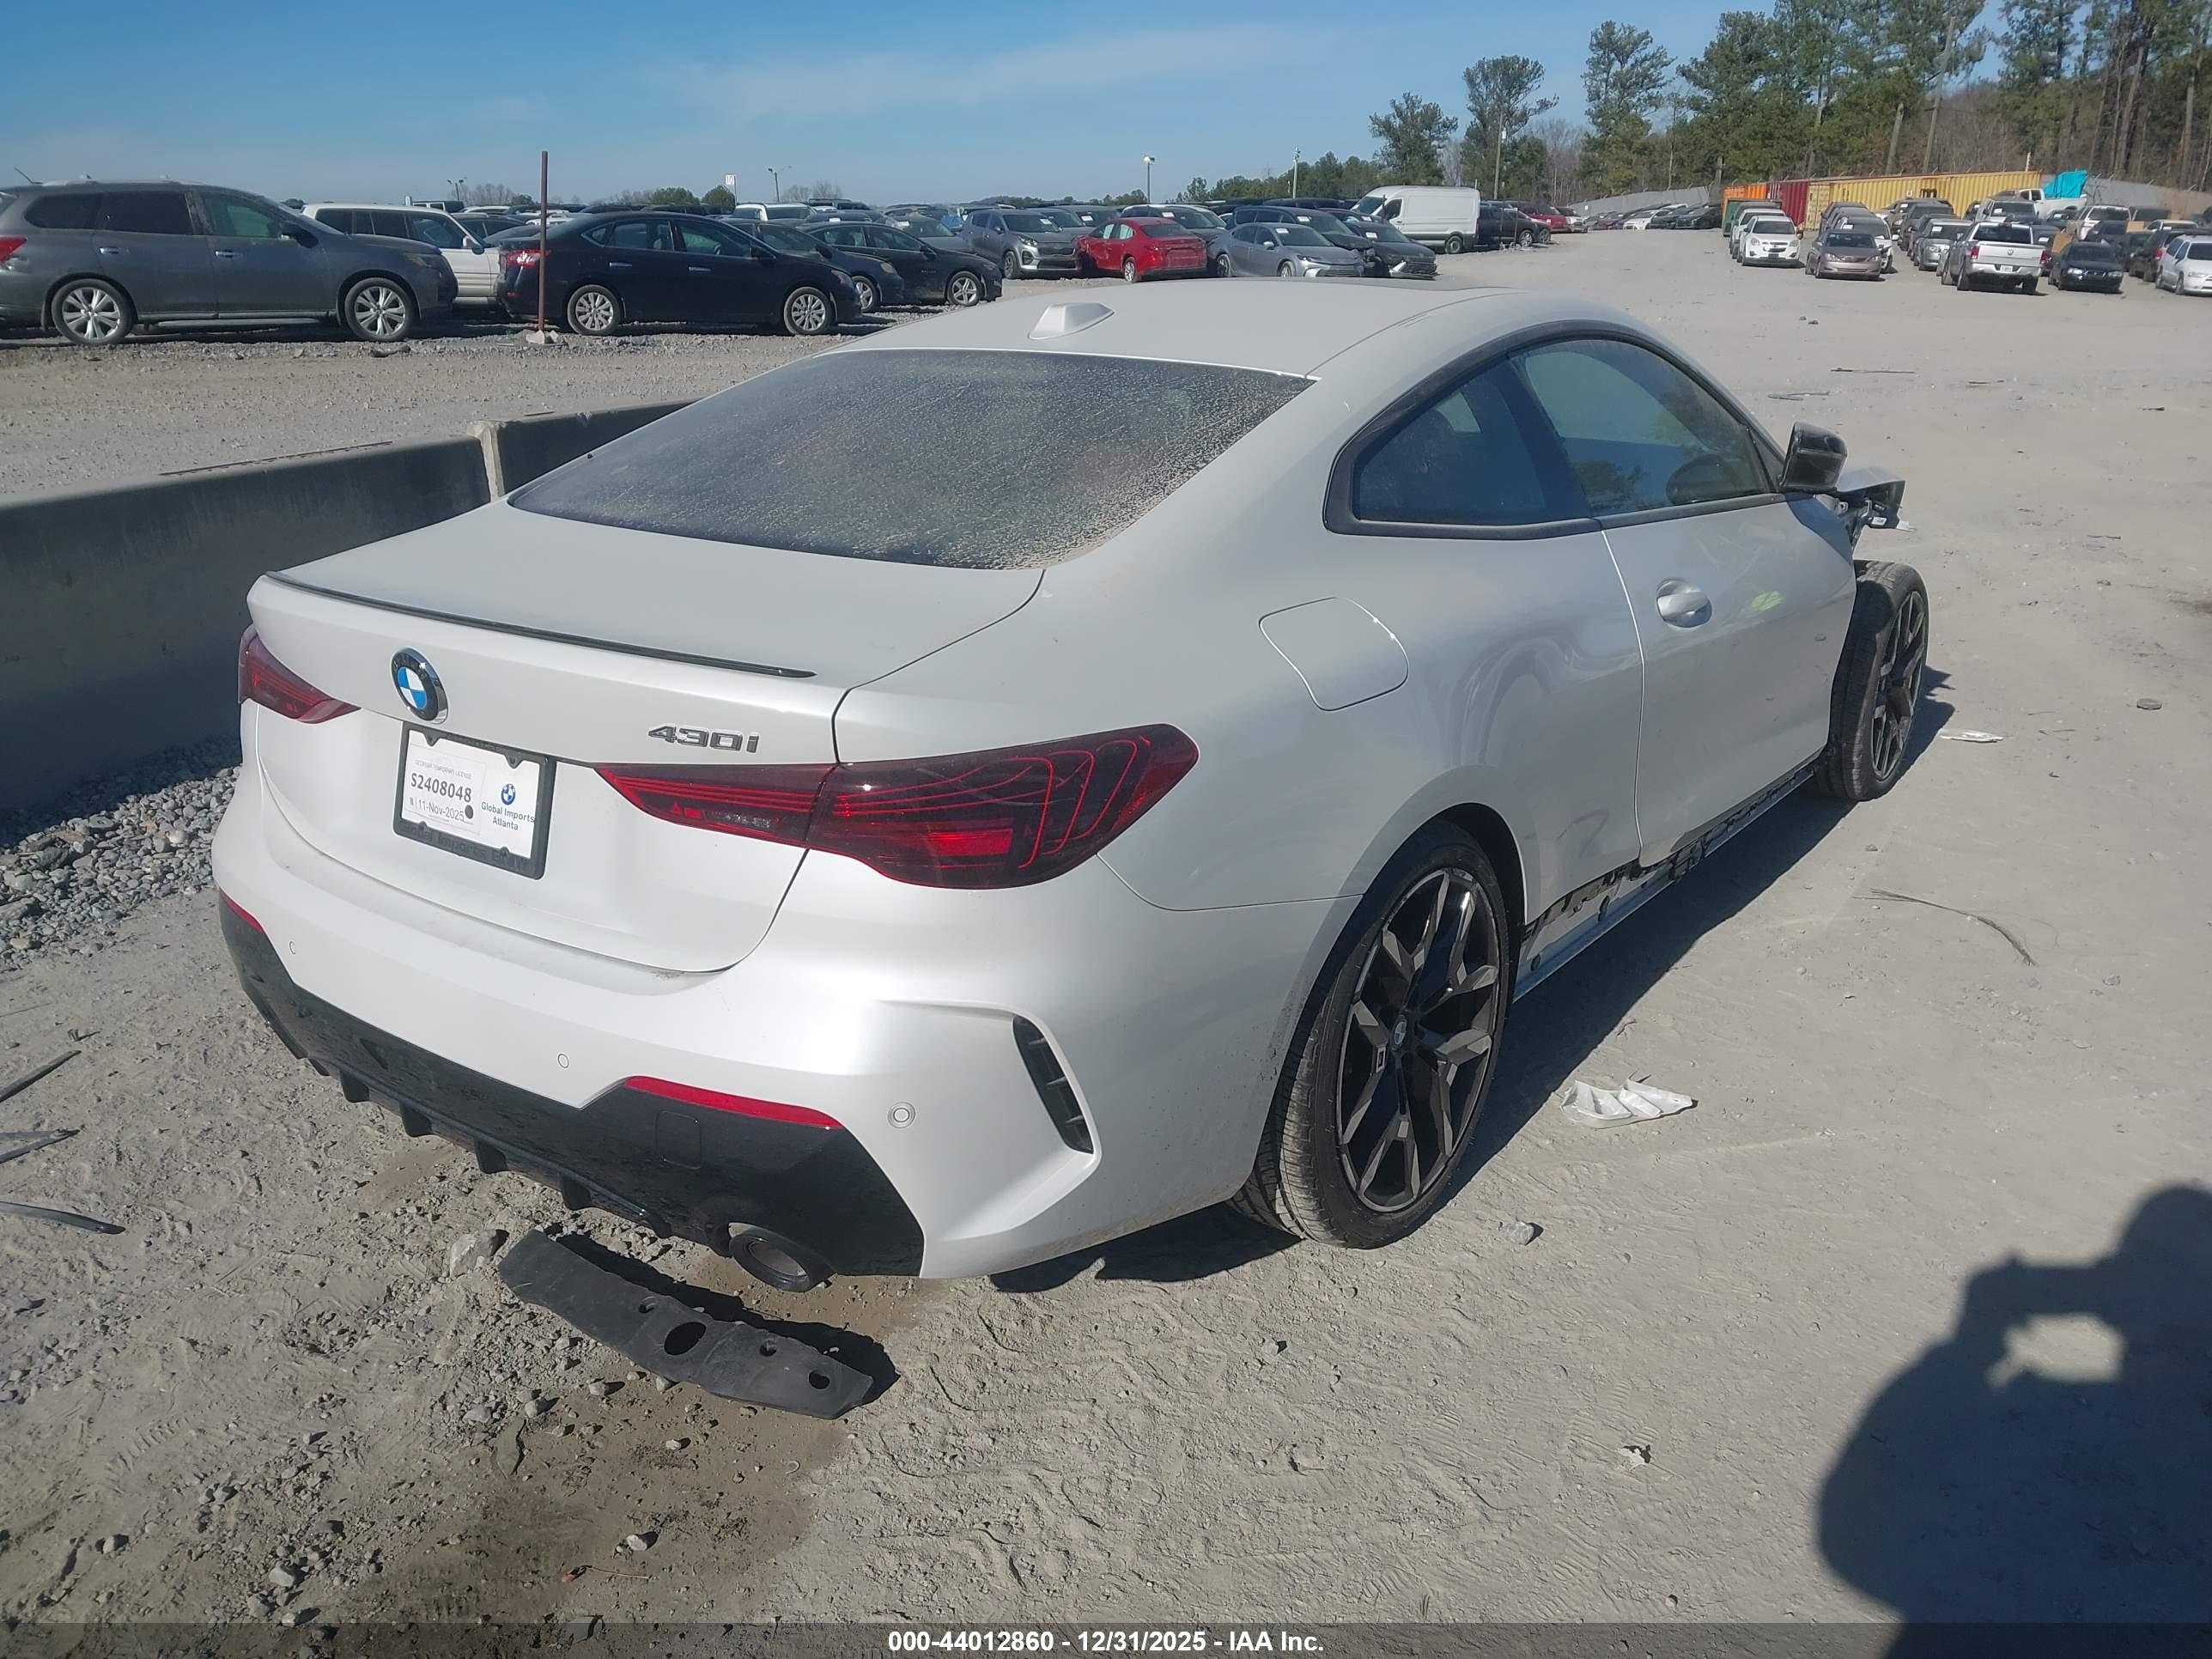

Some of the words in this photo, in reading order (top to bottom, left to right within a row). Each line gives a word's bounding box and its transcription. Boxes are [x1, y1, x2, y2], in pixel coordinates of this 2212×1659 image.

[647, 725, 760, 754] 430i
[410, 772, 472, 803] S2408048
[418, 799, 465, 822] 11-Nov-2025
[481, 801, 503, 815] Global
[504, 808, 535, 823] Imports
[492, 816, 519, 830] Atlanta
